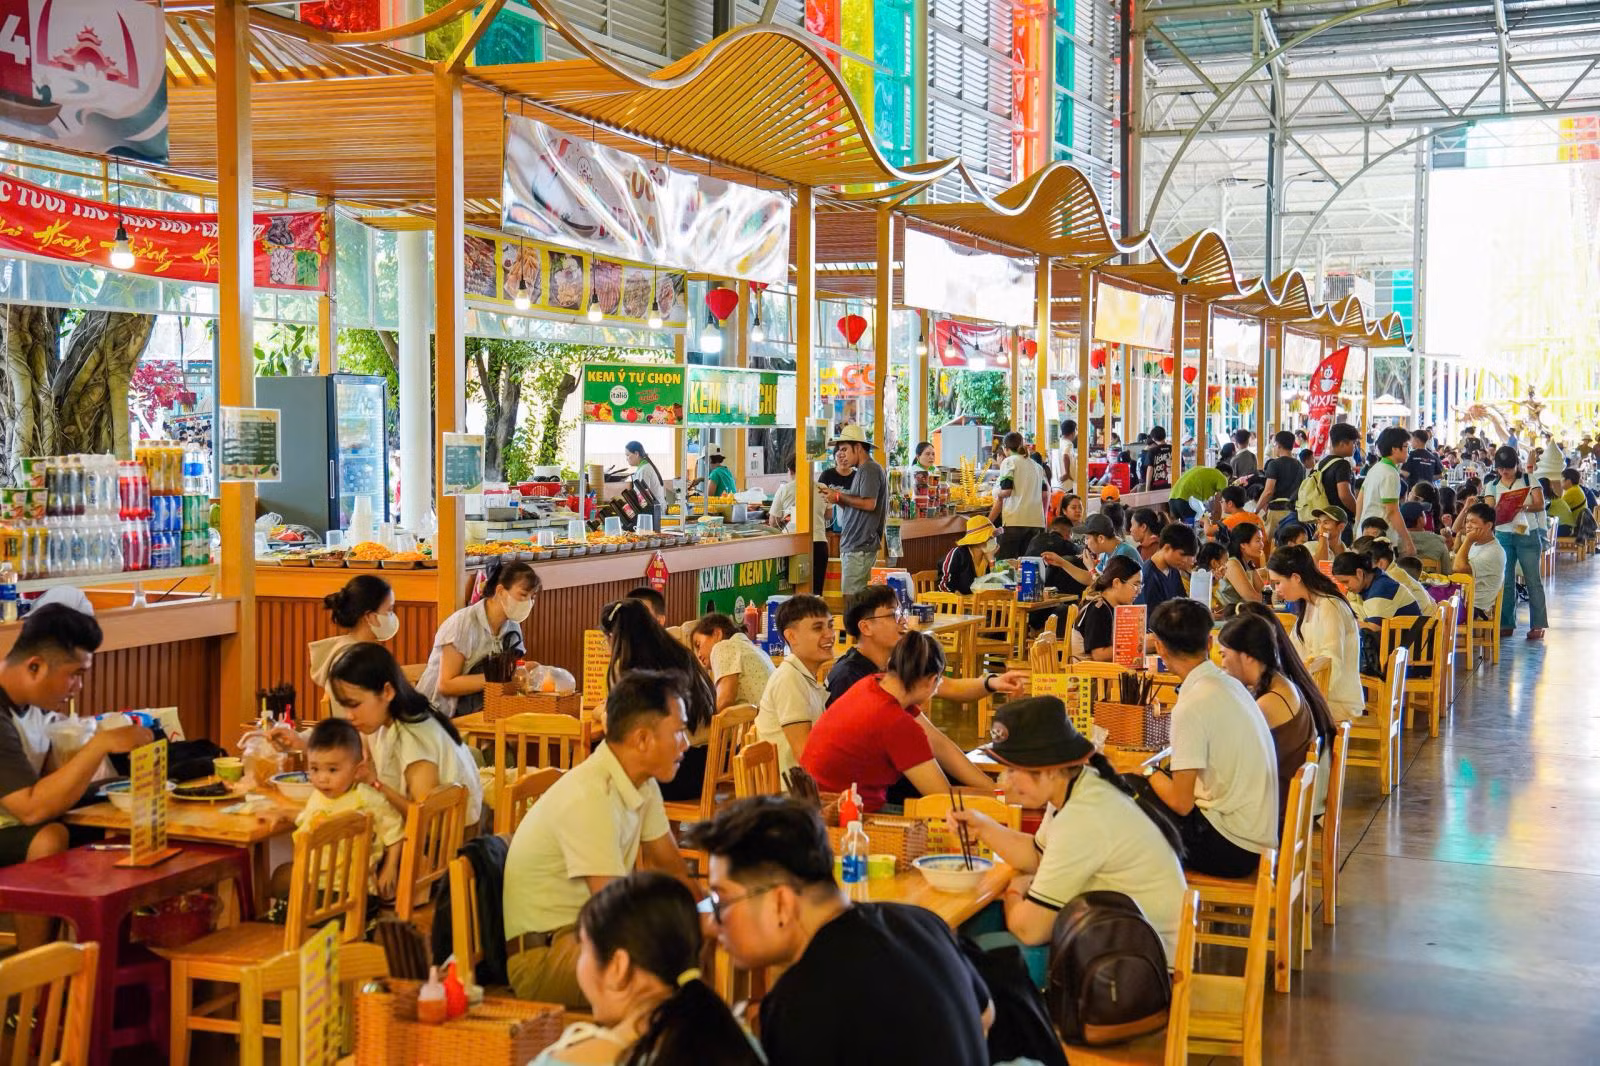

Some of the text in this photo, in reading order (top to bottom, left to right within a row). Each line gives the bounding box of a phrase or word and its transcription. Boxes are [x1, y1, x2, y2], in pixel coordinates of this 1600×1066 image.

[587, 367, 681, 387] KEM Ý TỰ CHỌN
[689, 381, 721, 414] KEM
